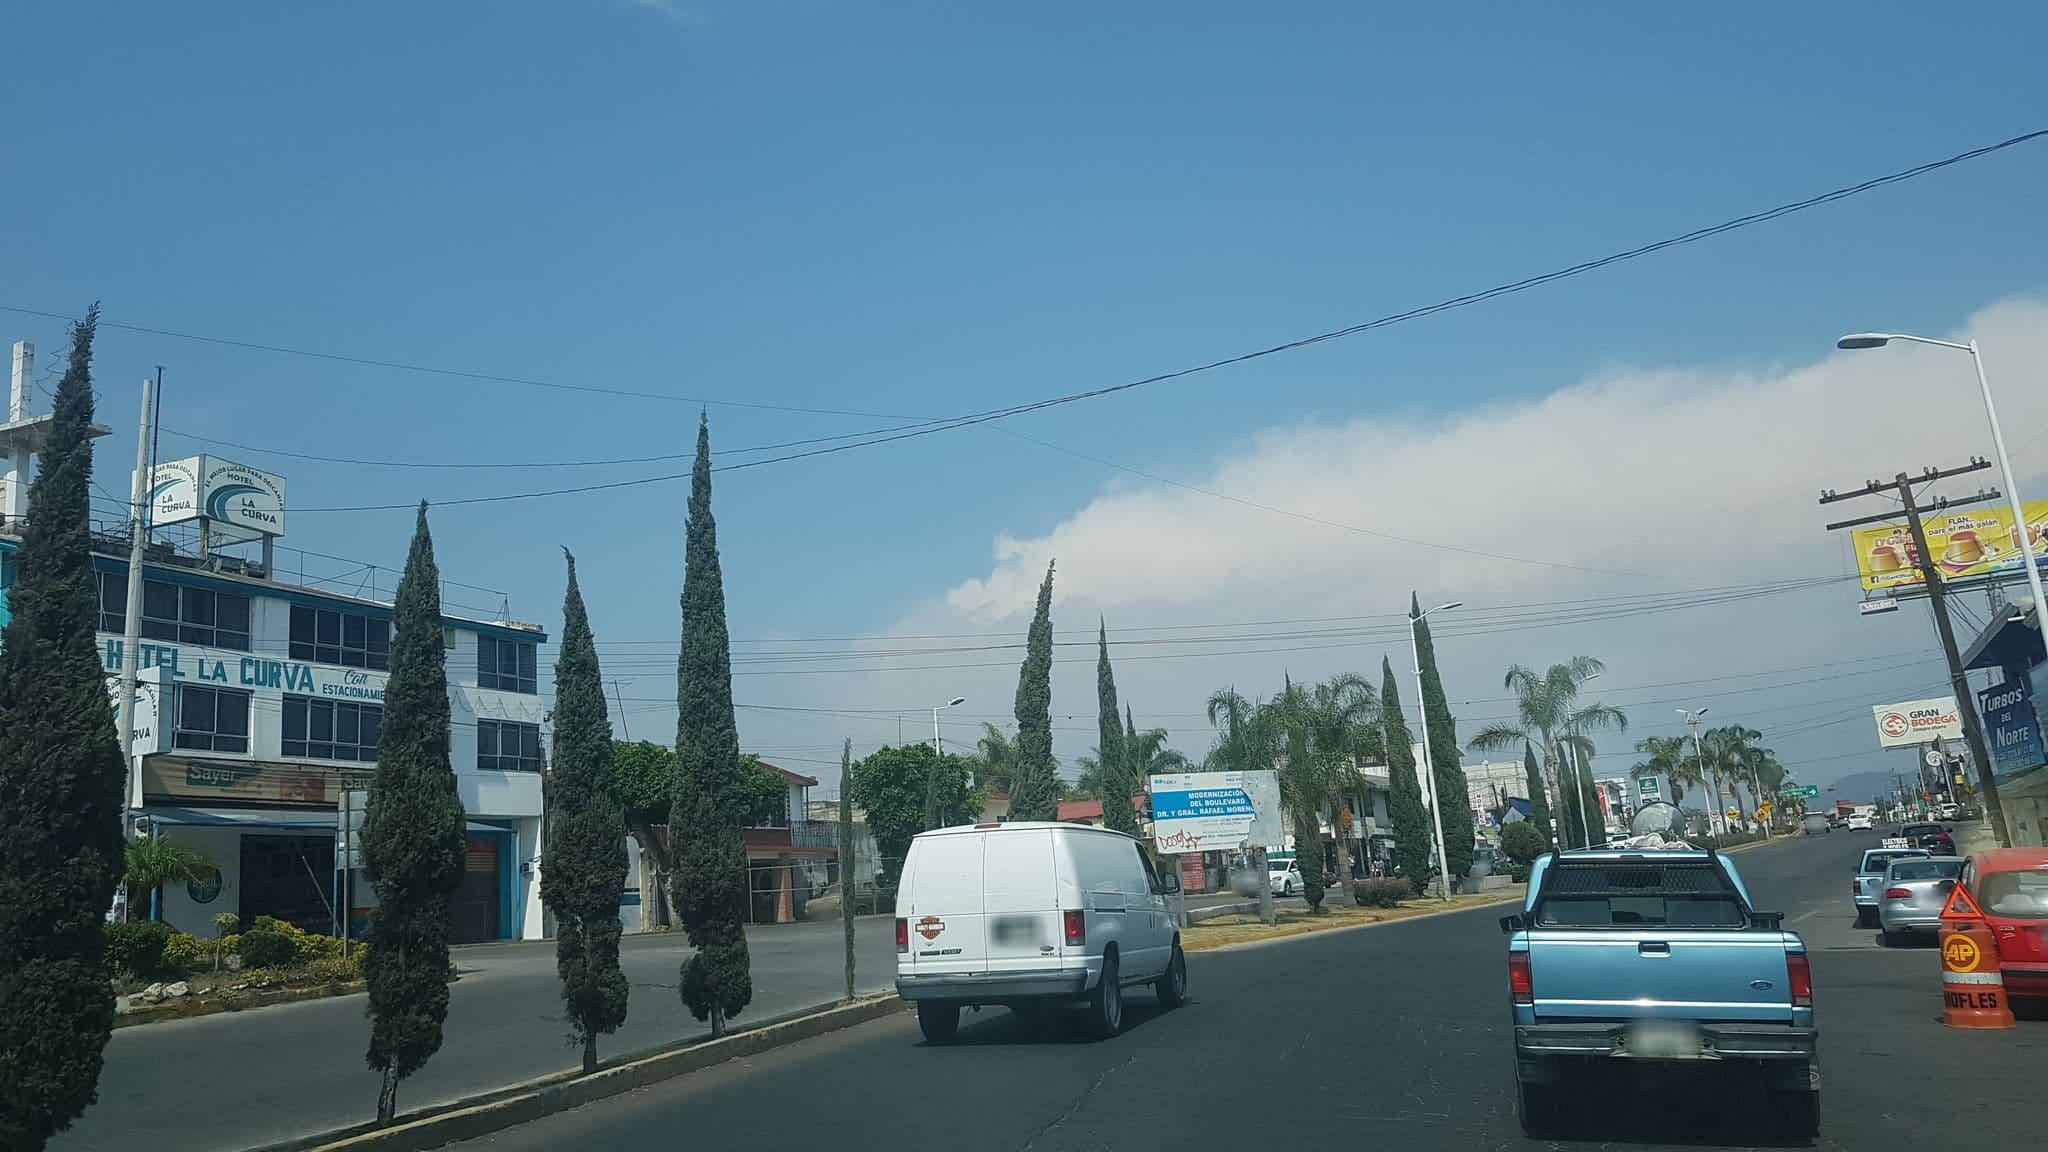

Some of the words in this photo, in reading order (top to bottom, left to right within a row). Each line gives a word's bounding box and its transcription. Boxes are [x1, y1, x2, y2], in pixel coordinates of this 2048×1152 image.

[226, 465, 247, 473] LUGAR
[154, 472, 172, 482] OTEL
[226, 472, 255, 486] HOTEL
[162, 493, 173, 504] LA
[241, 497, 256, 509] LA
[161, 499, 192, 514] CURVA
[240, 508, 278, 525] CURVA
[106, 638, 186, 678] HTEL
[198, 658, 228, 682] LA
[240, 657, 315, 693] CURVA
[344, 669, 369, 685] Con
[322, 683, 385, 701] ESTACIONAMIE
[1909, 708, 1939, 719] GRAN
[1911, 714, 1957, 727] BODEGA
[133, 727, 151, 741] RVA
[1996, 726, 2030, 748] NORTE
[190, 765, 236, 785] Sayer
[1204, 797, 1245, 806] BOULEVARD
[1177, 808, 1198, 816] GRAL.
[1199, 806, 1225, 815] RAFAEL
[1945, 943, 1974, 962] AP
